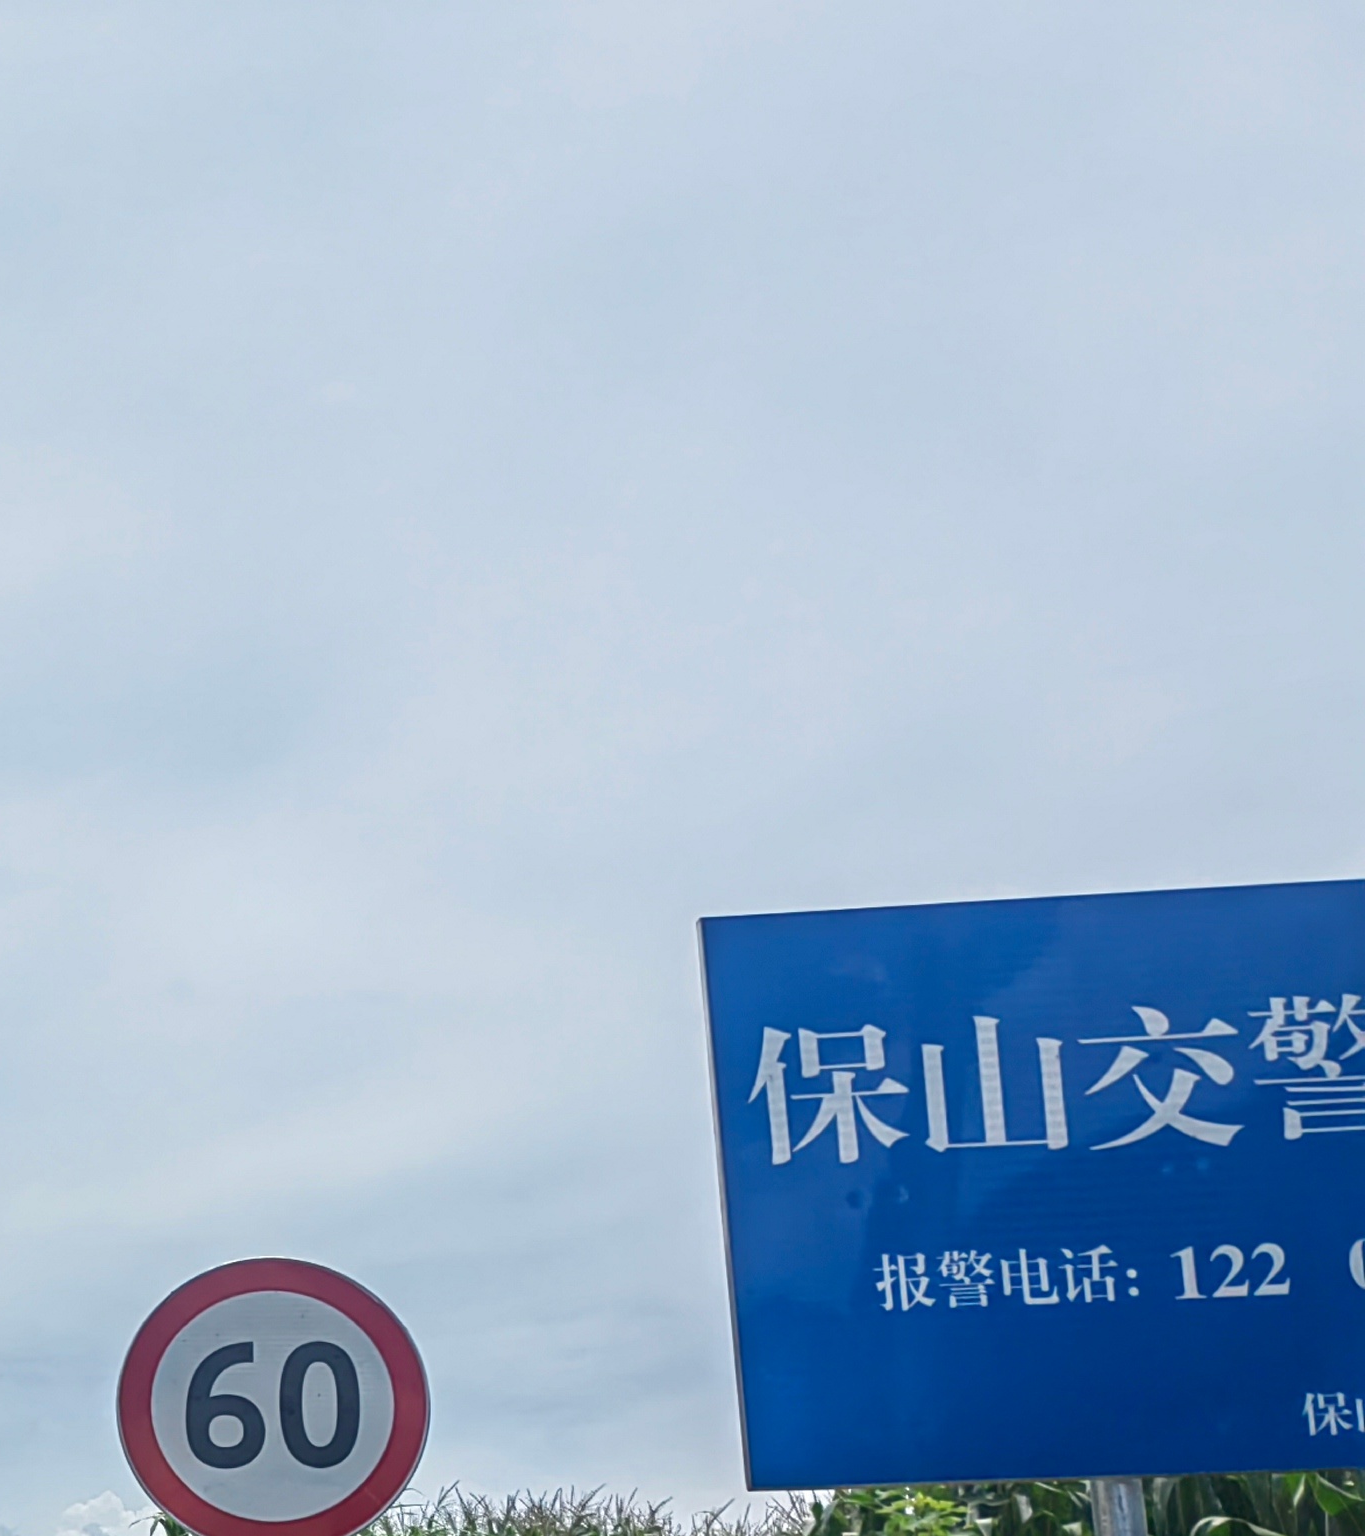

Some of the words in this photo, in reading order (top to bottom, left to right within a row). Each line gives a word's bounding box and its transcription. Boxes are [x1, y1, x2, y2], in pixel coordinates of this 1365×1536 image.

[748, 993, 1365, 1165] 保山交警
[185, 1341, 360, 1470] 60
[1302, 1391, 1365, 1437] 保
